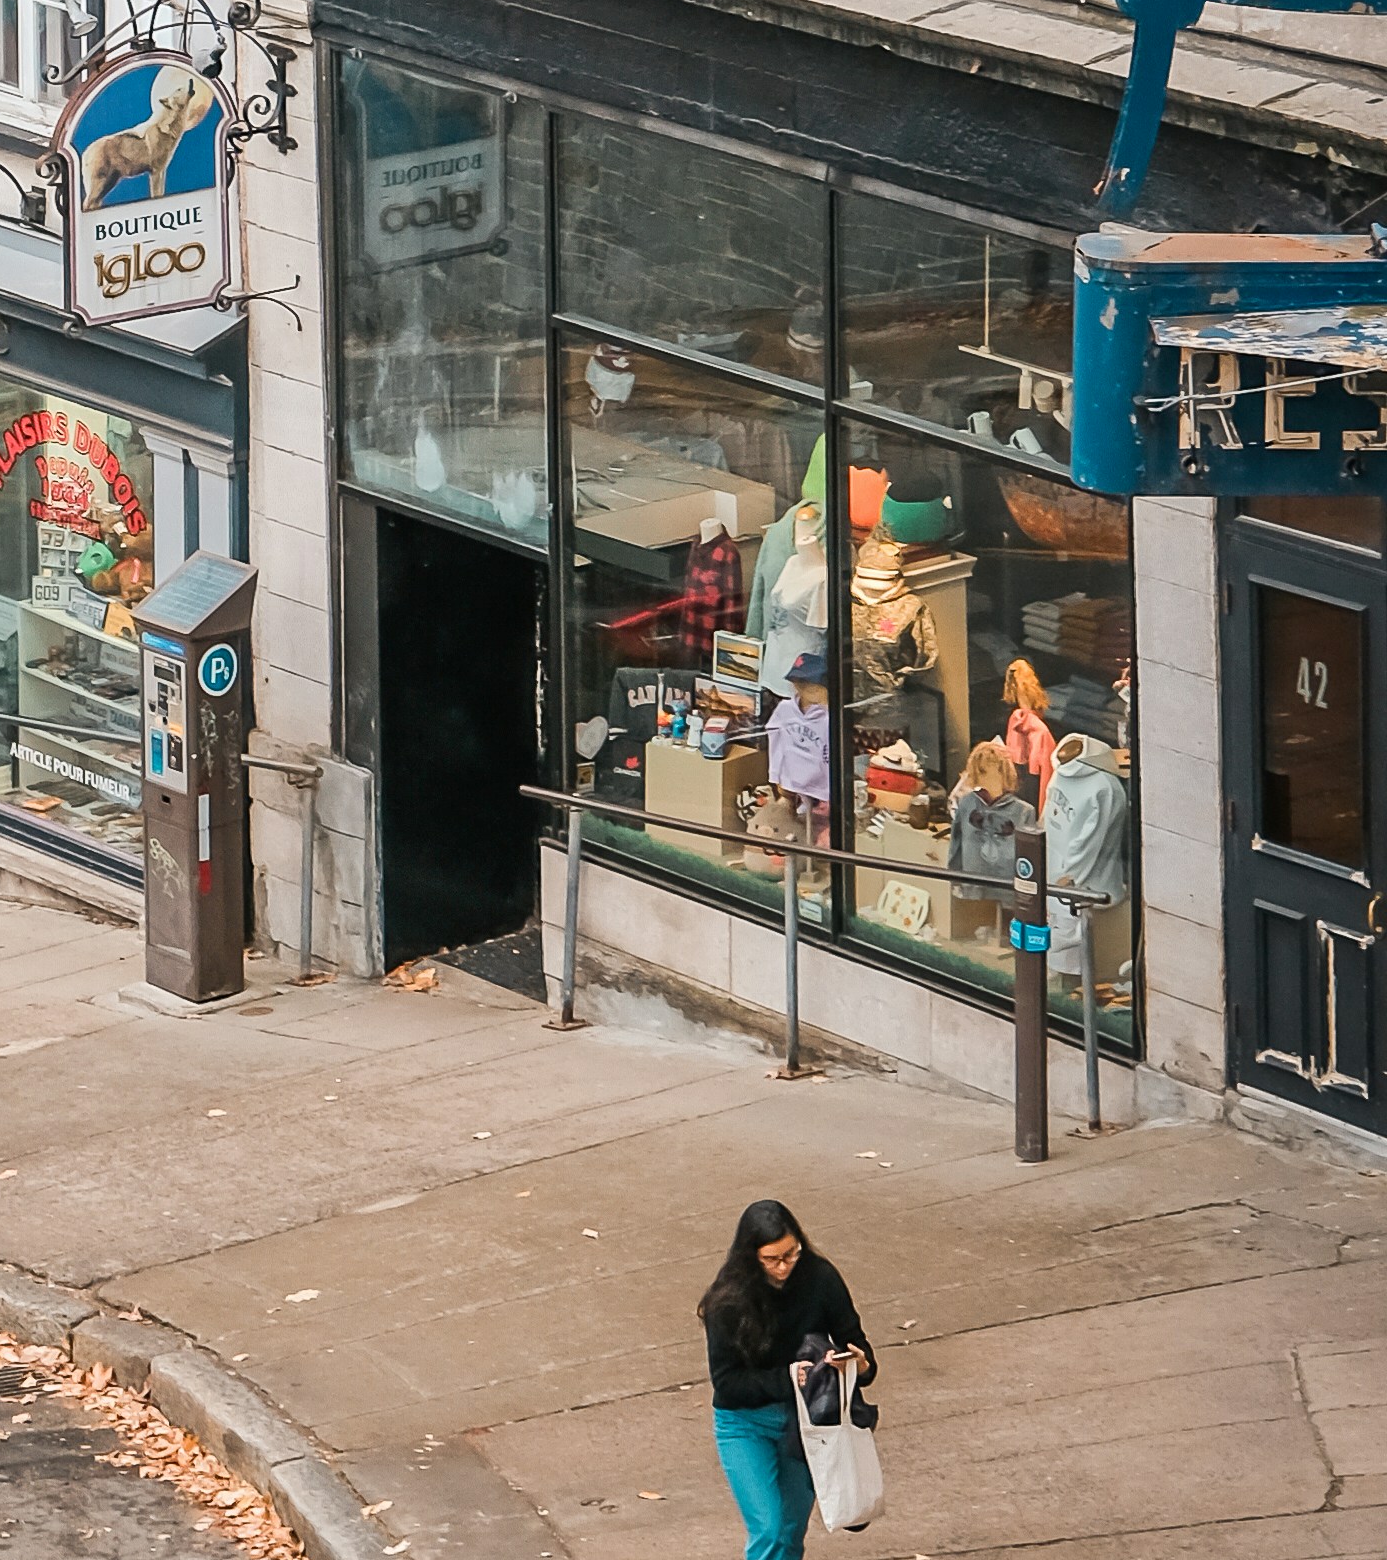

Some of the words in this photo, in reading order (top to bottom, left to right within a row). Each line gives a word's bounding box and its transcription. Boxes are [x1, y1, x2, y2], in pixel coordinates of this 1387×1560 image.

[95, 206, 203, 241] BOUTIQUE
[73, 420, 147, 537] DUBOIS
[1296, 656, 1328, 710] 42
[9, 741, 53, 772] ARTICLE
[52, 757, 85, 784] POUR
[84, 768, 131, 801] FUMEUR
